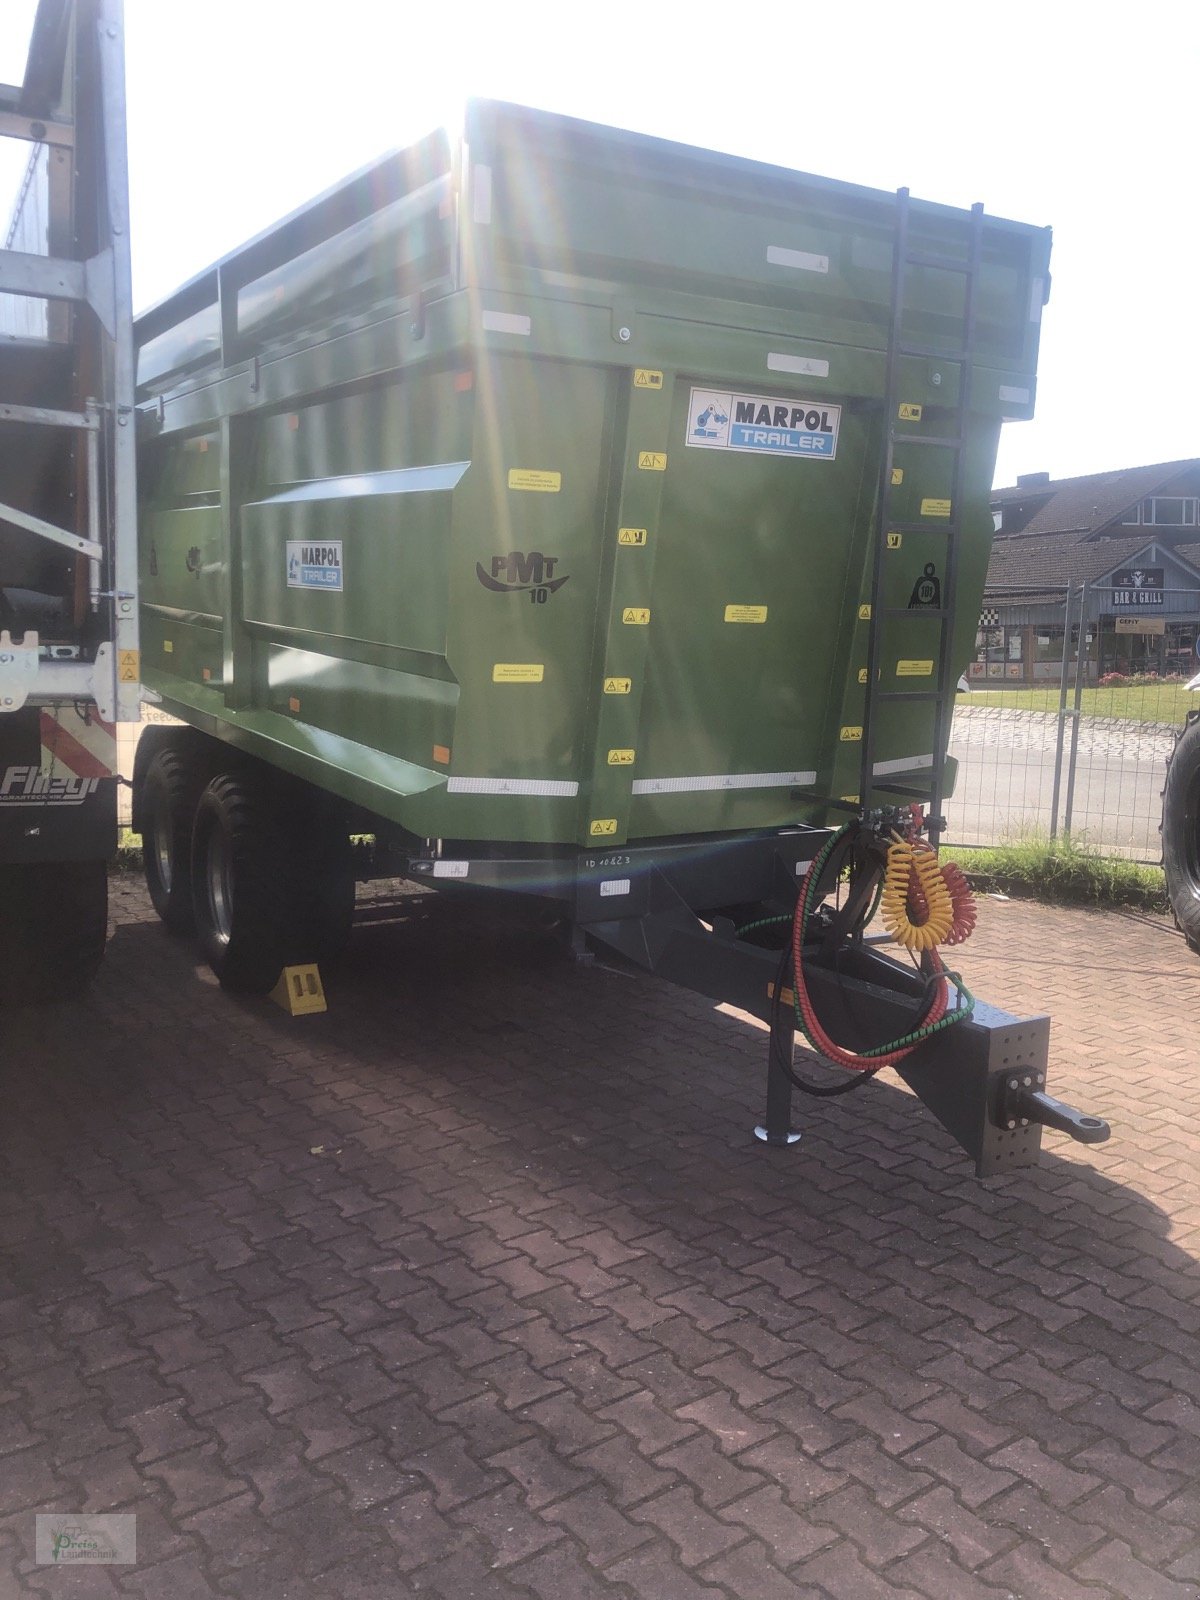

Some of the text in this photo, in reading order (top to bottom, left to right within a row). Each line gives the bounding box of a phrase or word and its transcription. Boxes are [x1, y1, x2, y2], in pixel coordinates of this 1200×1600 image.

[735, 401, 833, 432] MARPOL
[740, 428, 826, 450] TRAILER
[301, 547, 340, 566] MARPOL
[303, 570, 338, 583] TRAILER
[491, 551, 559, 584] PMT
[529, 588, 547, 604] 10
[1114, 591, 1130, 604] BAR
[1139, 591, 1162, 603] GRILL
